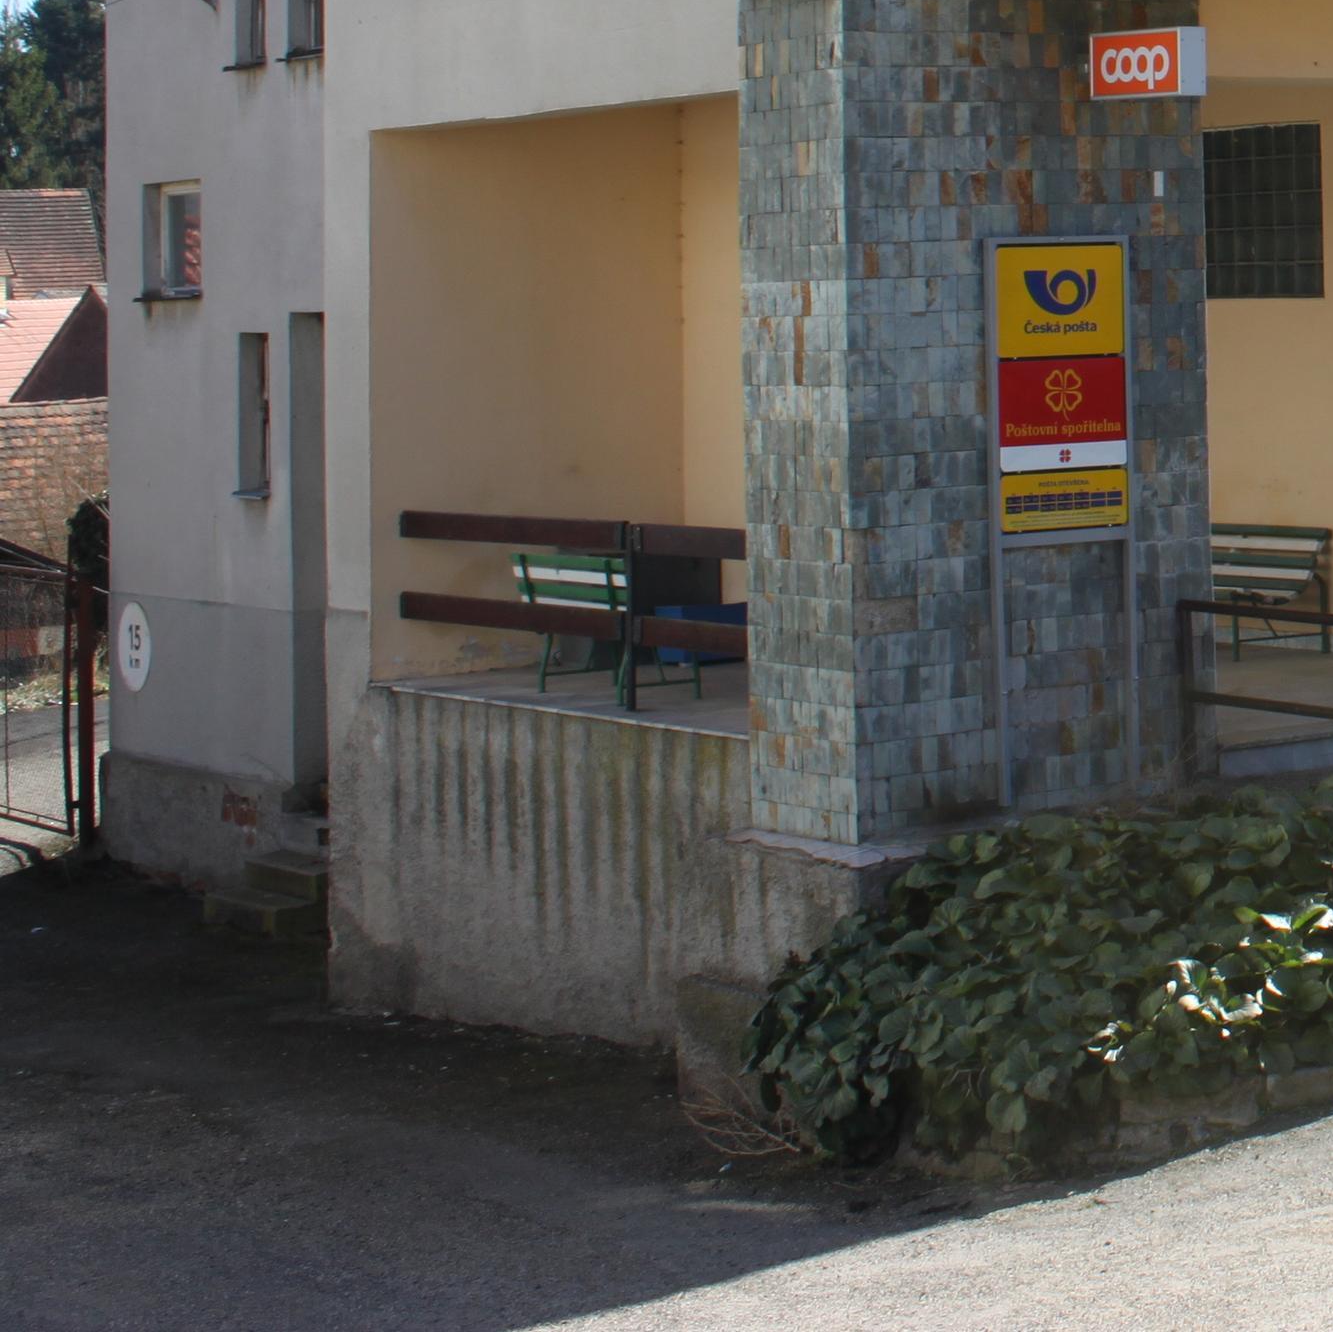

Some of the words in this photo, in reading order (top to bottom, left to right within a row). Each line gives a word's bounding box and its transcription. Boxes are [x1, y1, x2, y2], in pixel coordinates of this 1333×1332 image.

[1101, 44, 1170, 90] coop
[1024, 320, 1061, 334] Česká
[1064, 321, 1097, 335] pošta
[1006, 422, 1057, 437] Poštovní
[1061, 419, 1121, 437] spořitelna
[128, 624, 141, 650] 15
